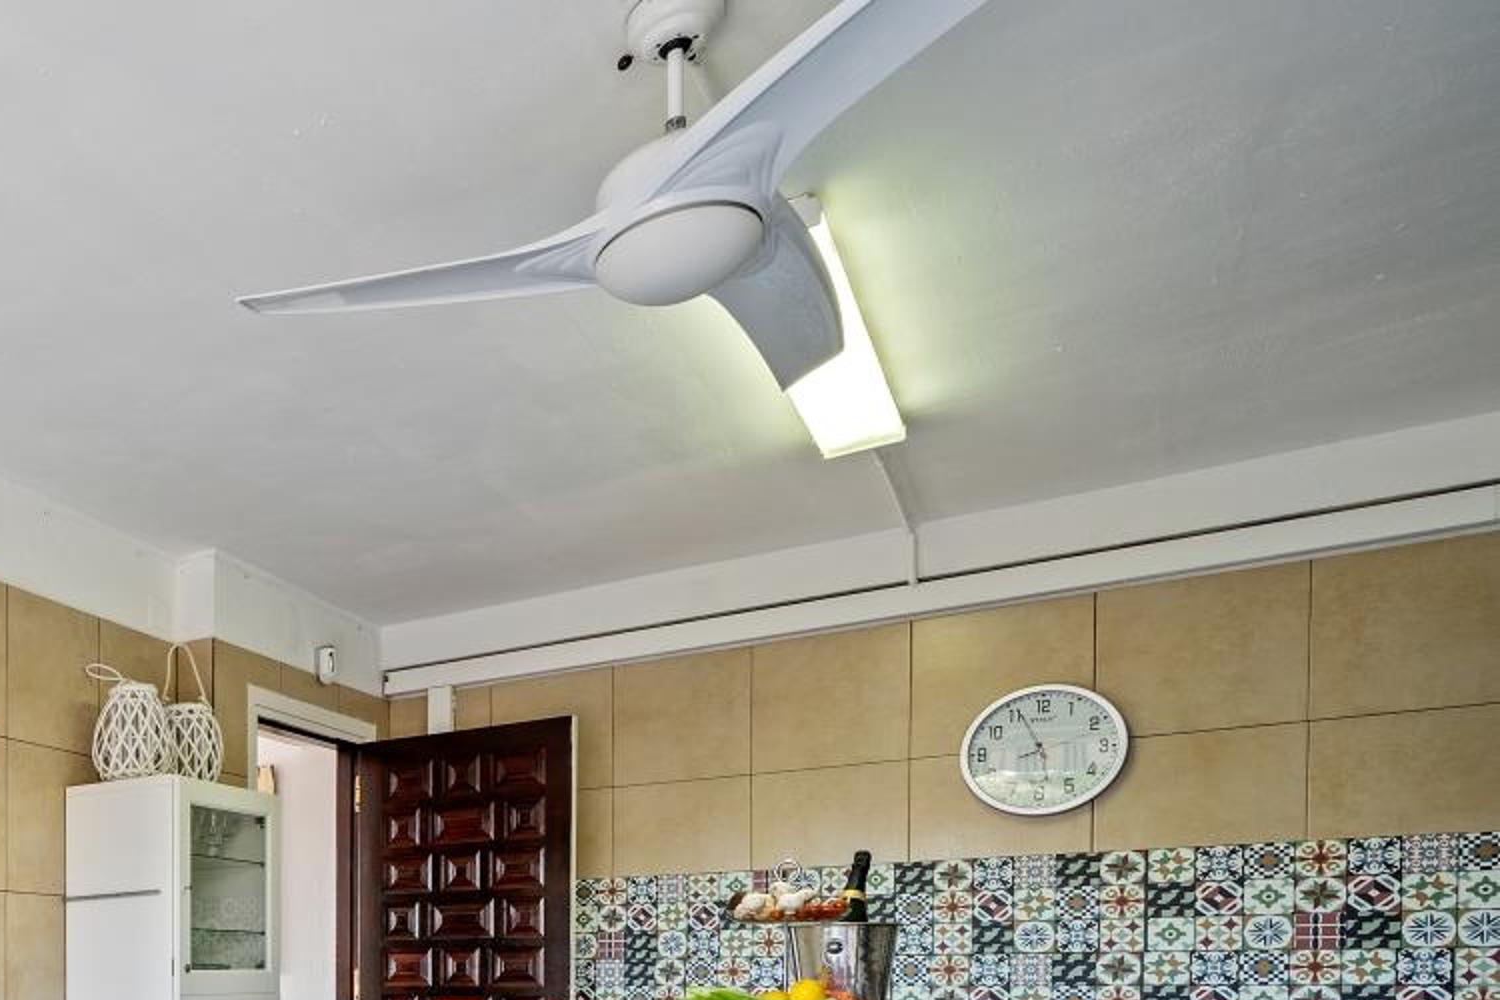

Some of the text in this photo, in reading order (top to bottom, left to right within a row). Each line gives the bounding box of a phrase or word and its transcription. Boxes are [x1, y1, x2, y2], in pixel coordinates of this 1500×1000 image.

[1036, 699, 1051, 713] 12
[1067, 701, 1074, 715] 1
[1089, 715, 1100, 730] 2
[989, 725, 1003, 740] 10
[1099, 738, 1109, 753] 3
[977, 747, 987, 763] 9
[1086, 762, 1097, 776] 4
[1064, 777, 1075, 793] 5
[1034, 786, 1045, 801] 6
